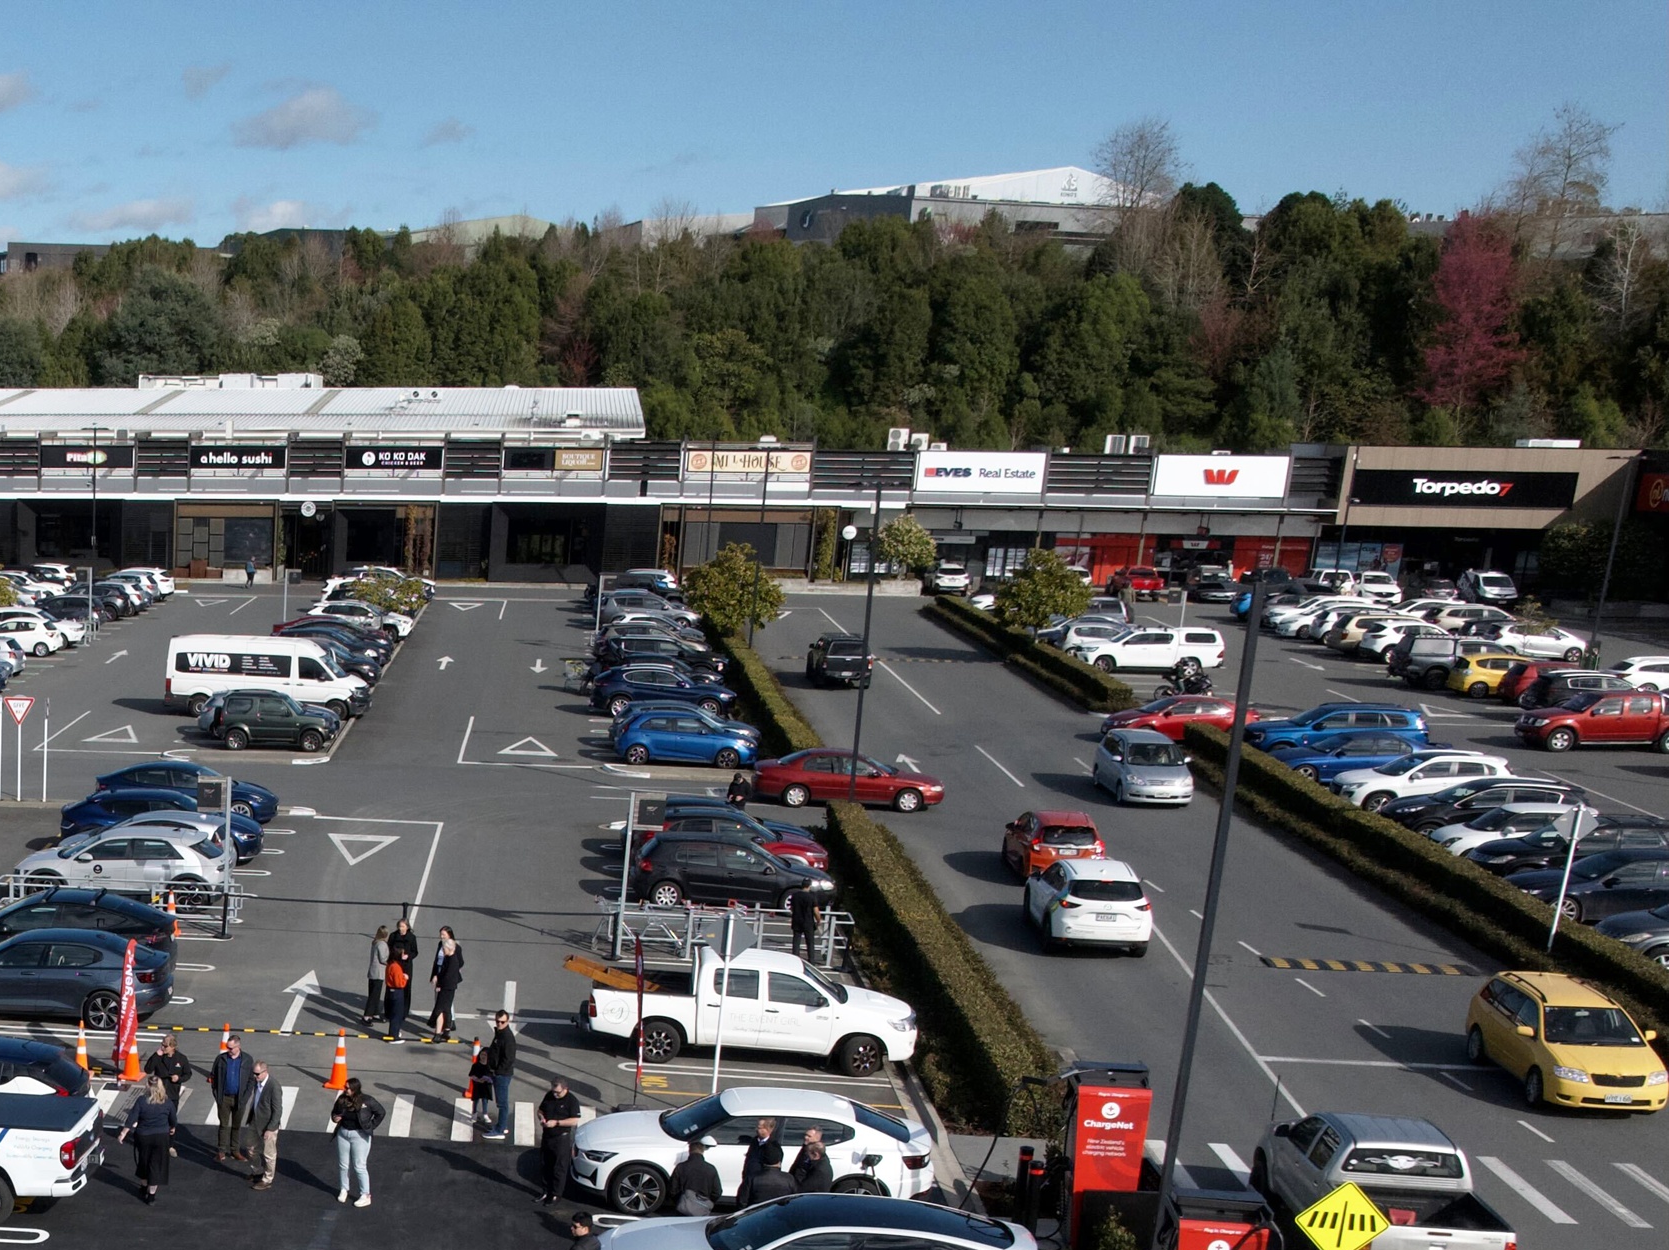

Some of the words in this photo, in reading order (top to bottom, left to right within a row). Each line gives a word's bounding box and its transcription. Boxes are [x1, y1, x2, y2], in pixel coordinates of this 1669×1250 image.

[242, 452, 272, 464] sushi
[379, 452, 391, 461] KO
[393, 452, 405, 461] KO
[407, 452, 426, 461] DAK
[935, 468, 972, 477] EVES
[979, 468, 1001, 478] Real
[1004, 468, 1036, 479] Estate
[1413, 478, 1514, 497] Torpedo7
[187, 653, 231, 668] VIVID
[1084, 1119, 1133, 1131] ChargeNet
